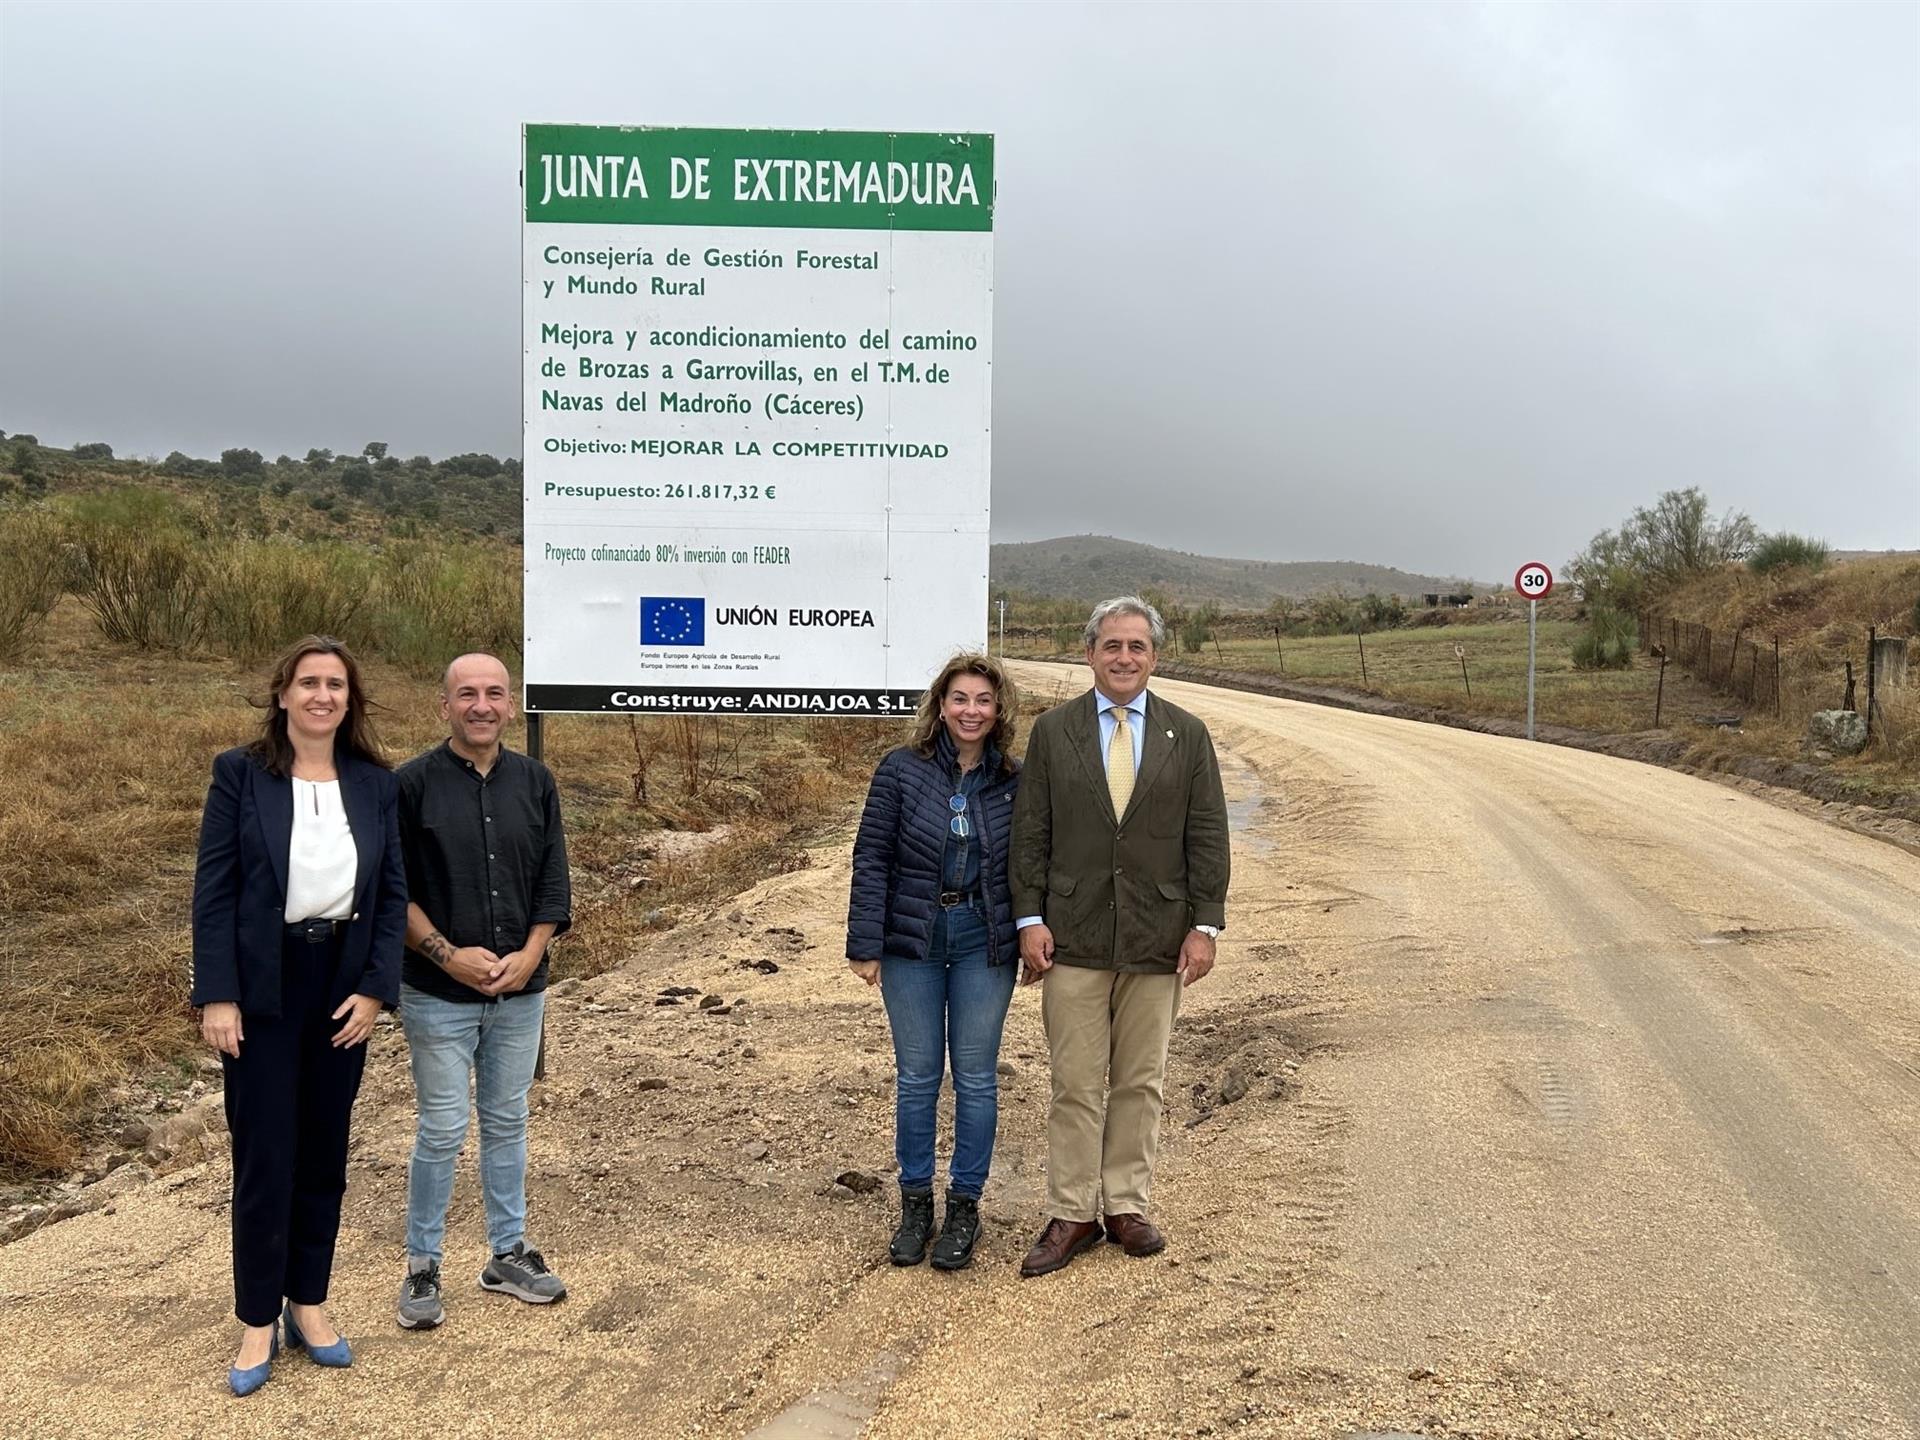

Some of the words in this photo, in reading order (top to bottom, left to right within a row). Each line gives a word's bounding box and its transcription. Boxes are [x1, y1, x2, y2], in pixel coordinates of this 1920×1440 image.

[541, 155, 648, 204] JUNTA
[671, 158, 710, 199] DE
[735, 159, 979, 205] EXTREMADURA
[544, 246, 654, 270] Consejería
[667, 248, 690, 266] de
[704, 249, 782, 267] Gestión
[797, 250, 878, 269] Forestal
[544, 281, 554, 298] y
[568, 275, 637, 294] Mundo
[652, 277, 704, 295] Rural
[542, 323, 614, 350] Mejora
[626, 331, 637, 351] y
[650, 326, 846, 348] acondicionamiento
[860, 329, 889, 349] del
[903, 330, 977, 350] camino
[542, 357, 565, 377] de
[580, 357, 649, 378] Brozas
[662, 365, 673, 379] a
[687, 359, 802, 385] Garrovillas,
[814, 367, 837, 381] en
[851, 362, 867, 382] el
[878, 361, 920, 383] T.M.
[926, 363, 949, 383] de
[543, 390, 603, 411] Navas
[616, 391, 646, 411] del
[661, 392, 751, 413] Madroño
[765, 393, 863, 421] (Cáceres)
[544, 439, 626, 456] Objetivo:
[632, 440, 723, 457] MEJORAR
[736, 442, 761, 455] LA
[773, 442, 948, 458] COMPETITIVIDAD
[545, 482, 660, 500] Presupuesto:
[665, 484, 758, 501] 261.817,32
[765, 486, 775, 499] €
[546, 543, 585, 566] Proyecto
[592, 544, 650, 562] cofinanciado
[657, 545, 678, 563] 80%
[684, 545, 726, 563] inversión
[732, 552, 748, 564] con
[754, 546, 790, 564] FEADER
[1523, 574, 1545, 587] 30
[716, 605, 777, 625] UNIÓN
[790, 609, 874, 627] EUROPEA
[610, 691, 742, 711] Construye:
[749, 693, 871, 711] ANDIAJOA
